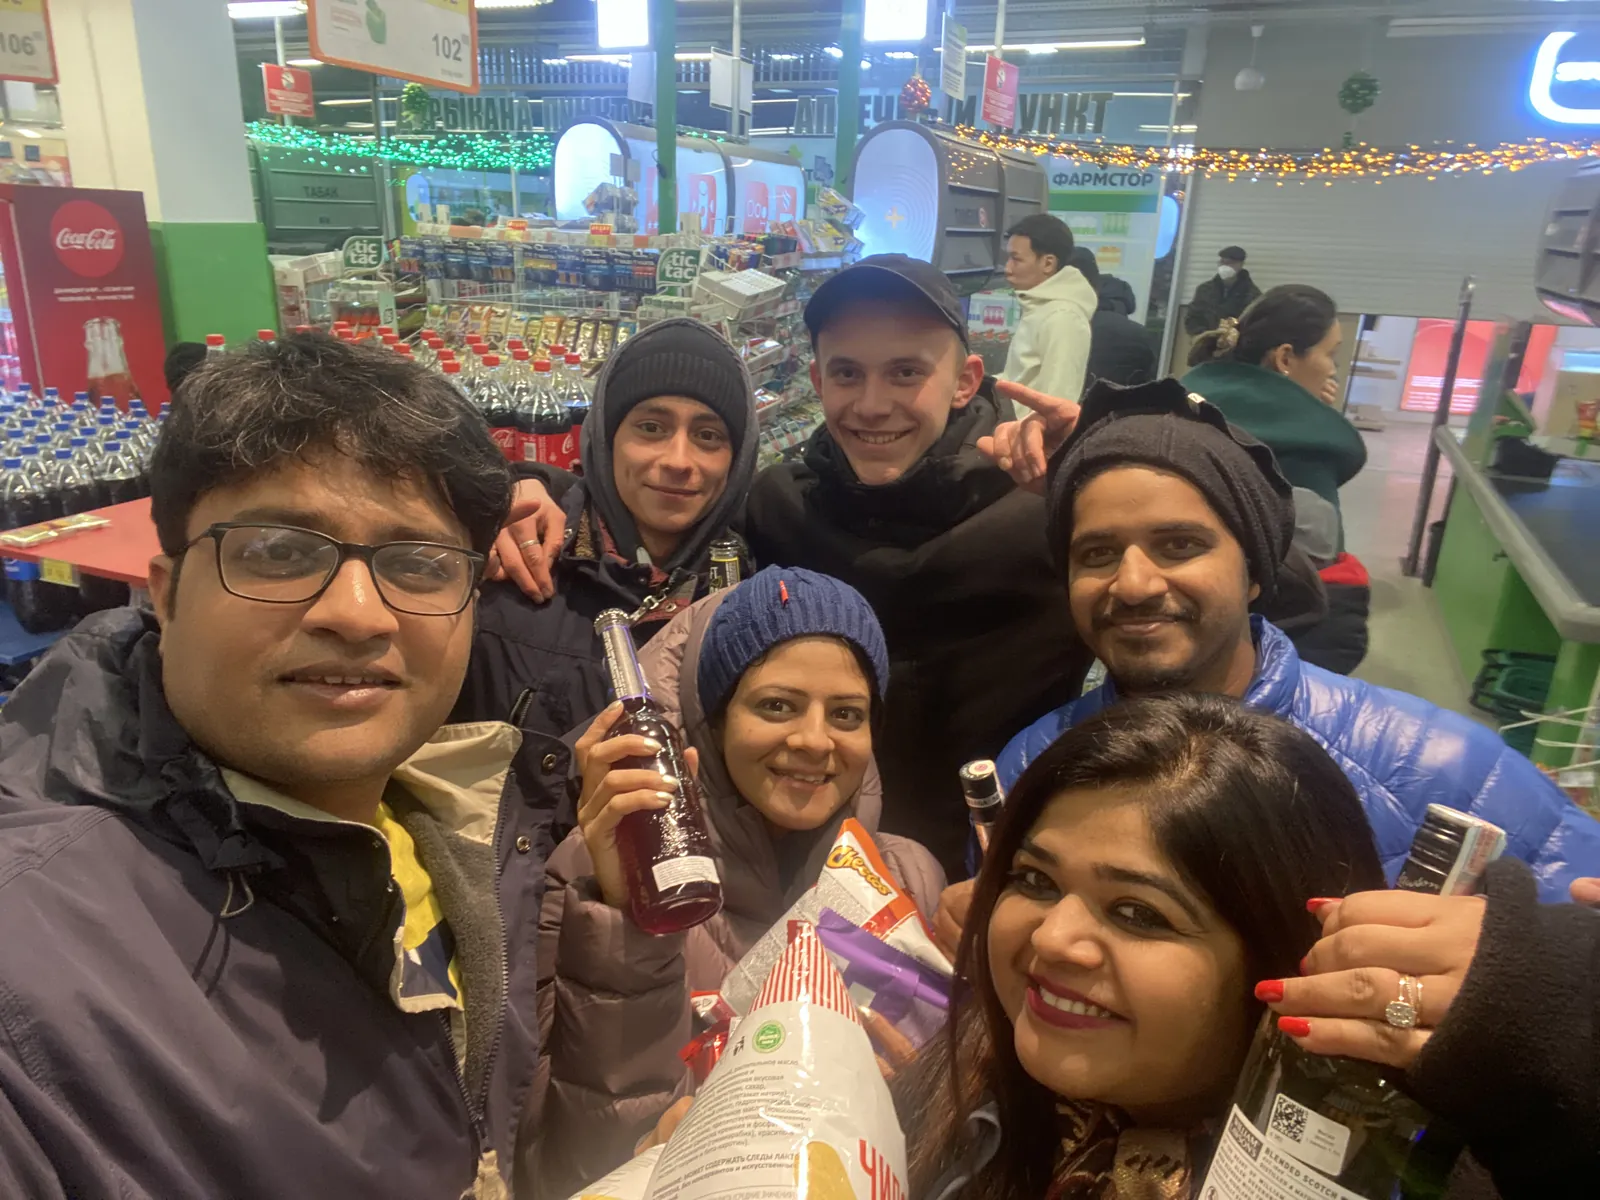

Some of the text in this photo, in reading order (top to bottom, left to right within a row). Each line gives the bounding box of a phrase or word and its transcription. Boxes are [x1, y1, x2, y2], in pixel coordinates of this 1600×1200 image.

[431, 33, 462, 62] 102
[1052, 172, 1154, 187] ФАРМСТОР
[354, 240, 378, 254] tic
[350, 252, 378, 265] tac
[671, 251, 697, 268] tic
[664, 263, 695, 280] tac
[826, 844, 892, 896] Cheetos
[746, 1153, 773, 1161] СЛЕДЫ
[859, 1138, 906, 1200] ЧИП
[1264, 1147, 1301, 1177] BLENDED
[1303, 1174, 1339, 1200] SCOTCH
